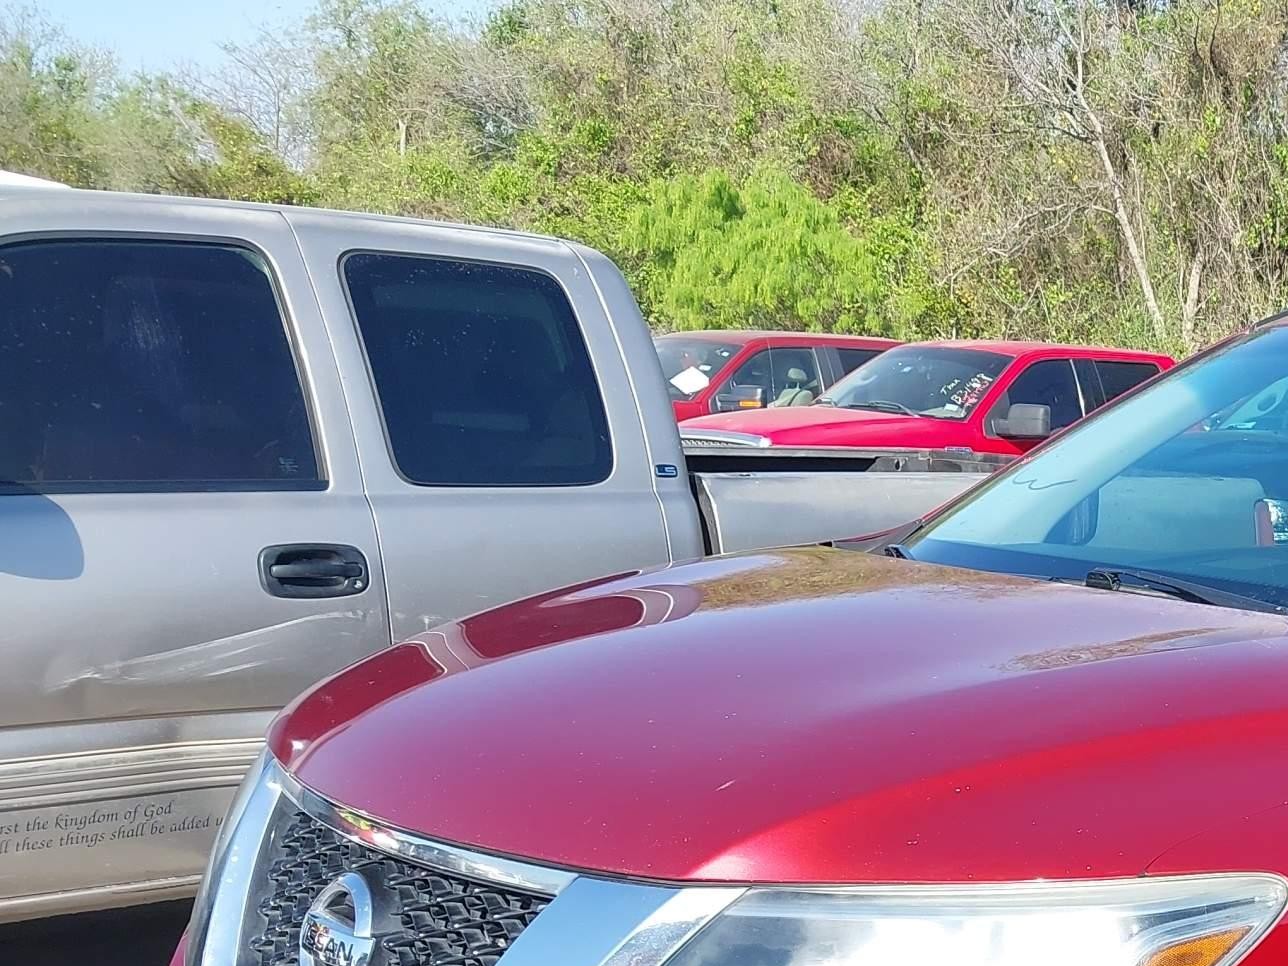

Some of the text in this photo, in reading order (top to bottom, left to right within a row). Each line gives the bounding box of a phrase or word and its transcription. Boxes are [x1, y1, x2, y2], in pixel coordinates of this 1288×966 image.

[655, 466, 678, 476] LS
[0, 799, 176, 835] rst the kingdom of God
[0, 838, 12, 855] ll
[15, 836, 54, 853] these
[59, 830, 105, 848] things
[109, 822, 147, 841] shall
[150, 820, 165, 836] be
[169, 813, 211, 833] added
